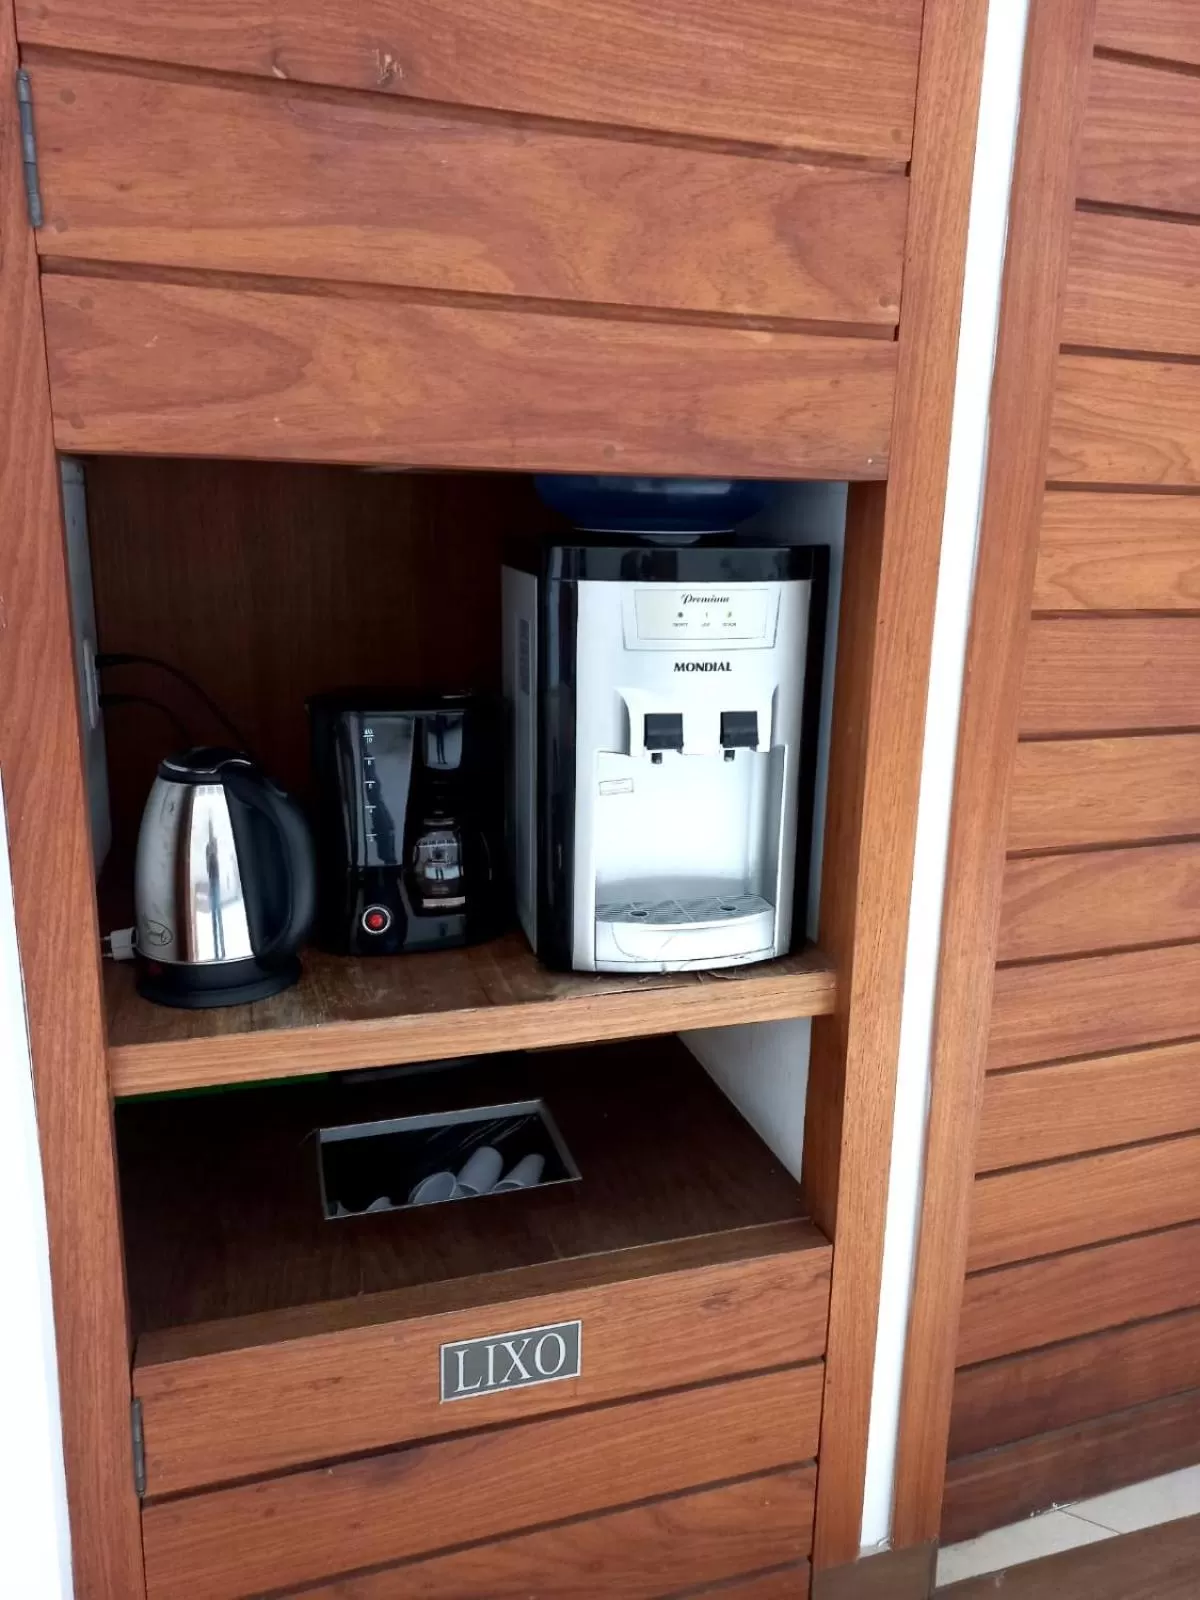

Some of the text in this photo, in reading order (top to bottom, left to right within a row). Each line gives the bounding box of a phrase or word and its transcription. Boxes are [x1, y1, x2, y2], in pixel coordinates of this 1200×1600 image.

[681, 593, 730, 604] Premium
[673, 661, 733, 672] MONDIAL
[453, 1332, 566, 1393] LIXO
